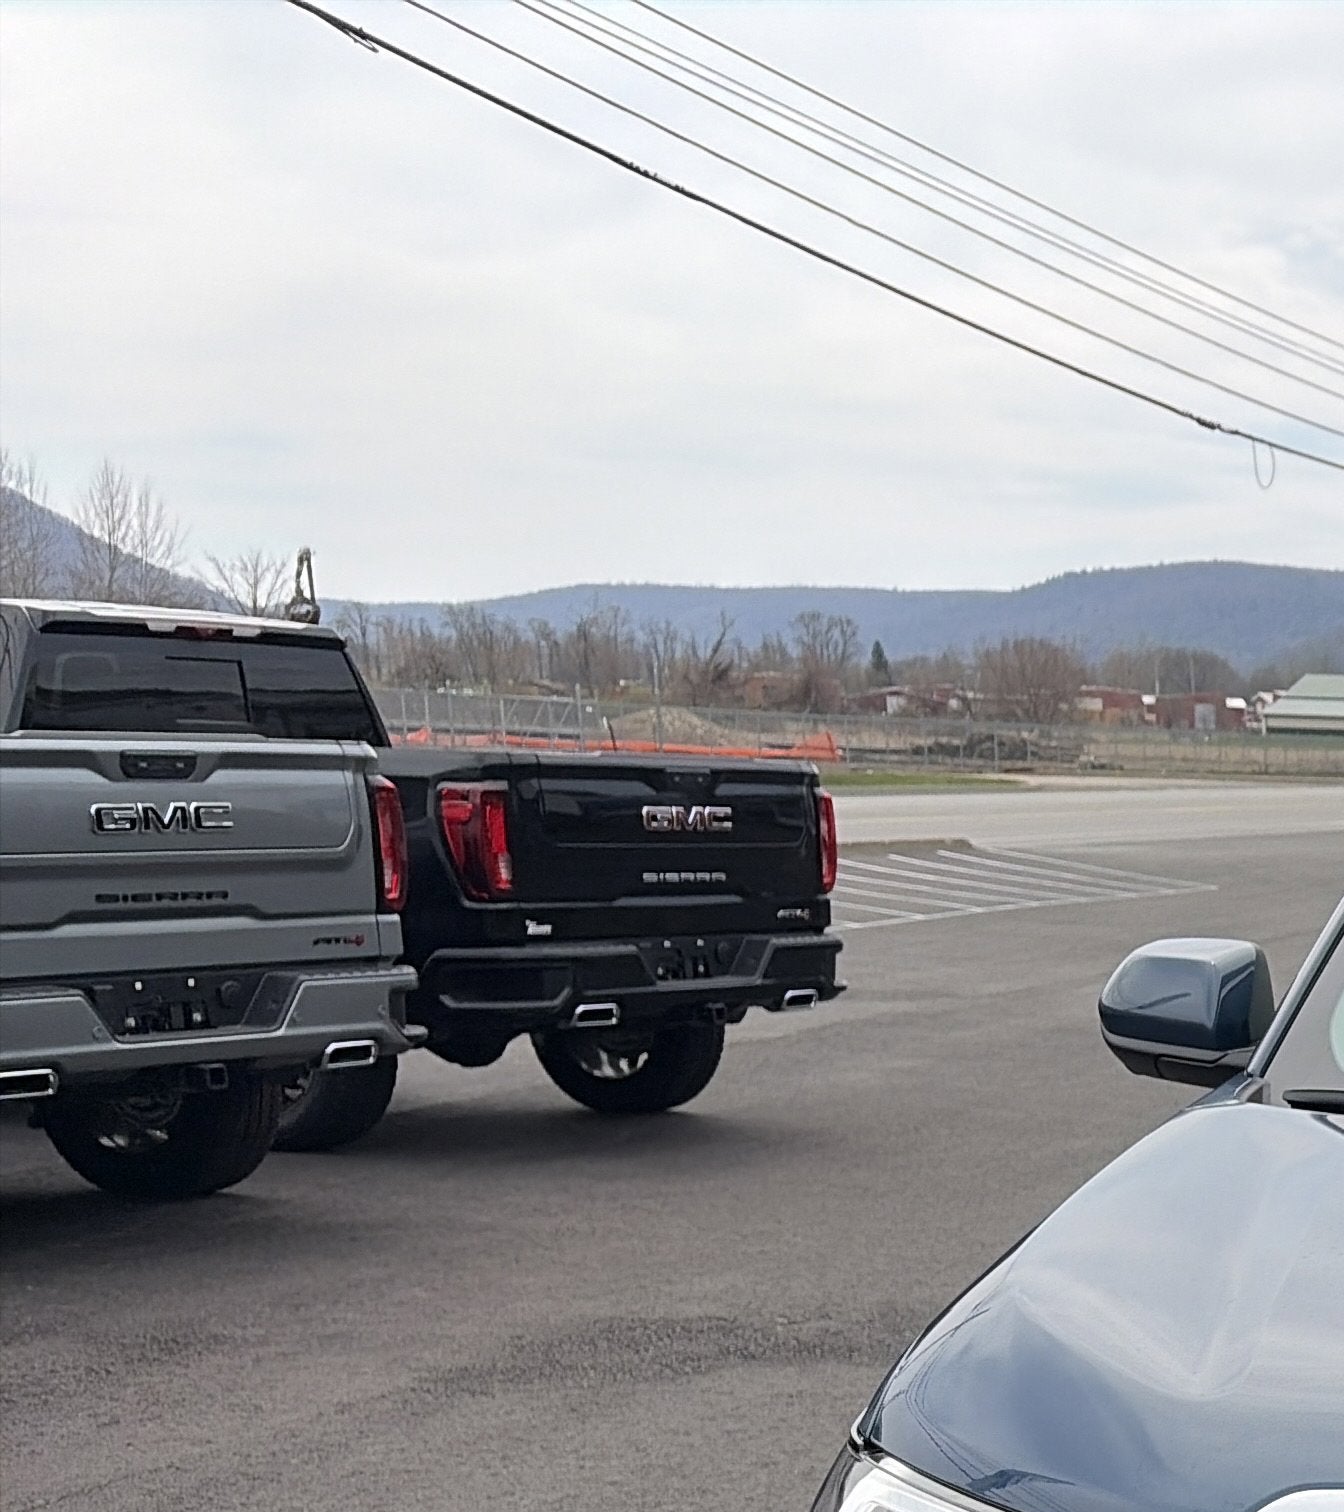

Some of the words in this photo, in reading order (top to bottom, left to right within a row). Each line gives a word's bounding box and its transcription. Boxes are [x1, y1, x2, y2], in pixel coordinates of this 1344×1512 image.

[90, 801, 234, 834] GMC
[642, 805, 733, 832] GMC
[643, 872, 727, 883] SIERRA
[95, 890, 229, 904] SIERRA
